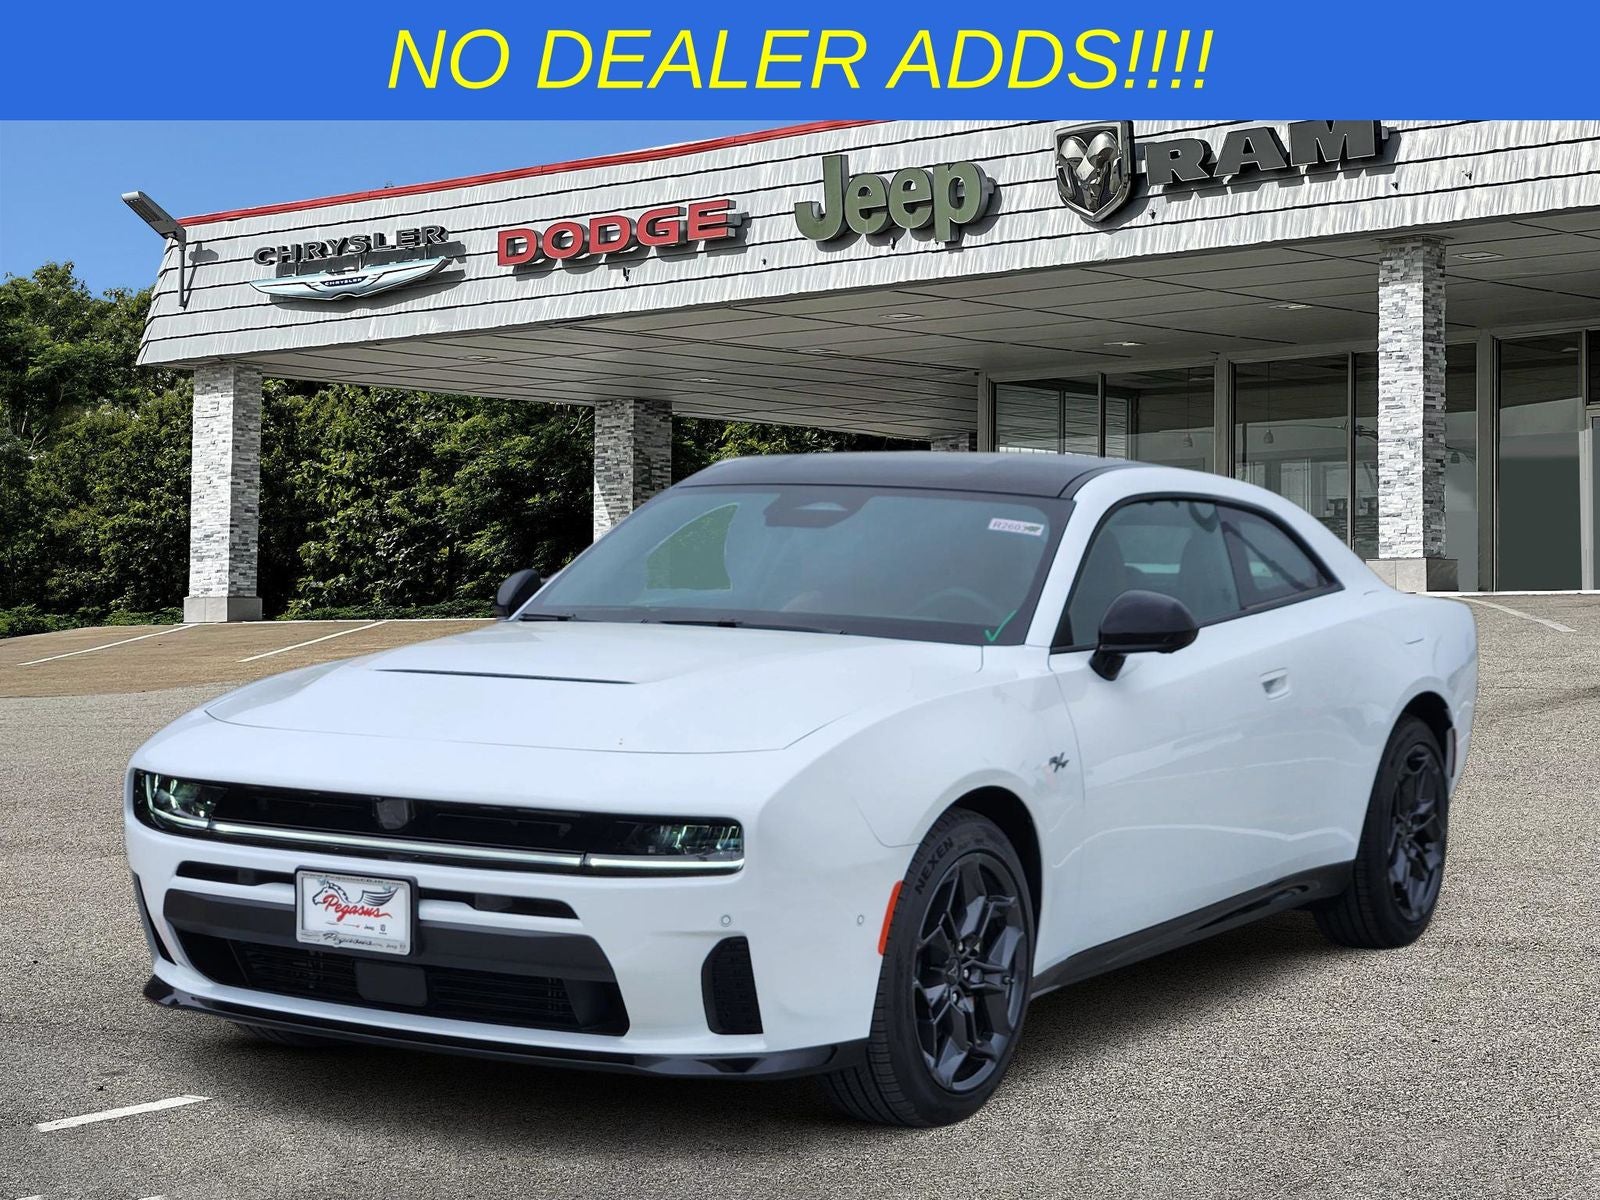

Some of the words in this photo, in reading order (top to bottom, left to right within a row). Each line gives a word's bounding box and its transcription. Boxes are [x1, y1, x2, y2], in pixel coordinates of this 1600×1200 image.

[1145, 120, 1376, 186] RAM
[794, 154, 990, 242] Jeep
[253, 225, 448, 266] CHRYSLER
[498, 199, 736, 266] DODGE
[324, 278, 362, 286] CHRYSLER
[914, 836, 955, 895] NEXEN
[323, 894, 392, 922] Pegasus
